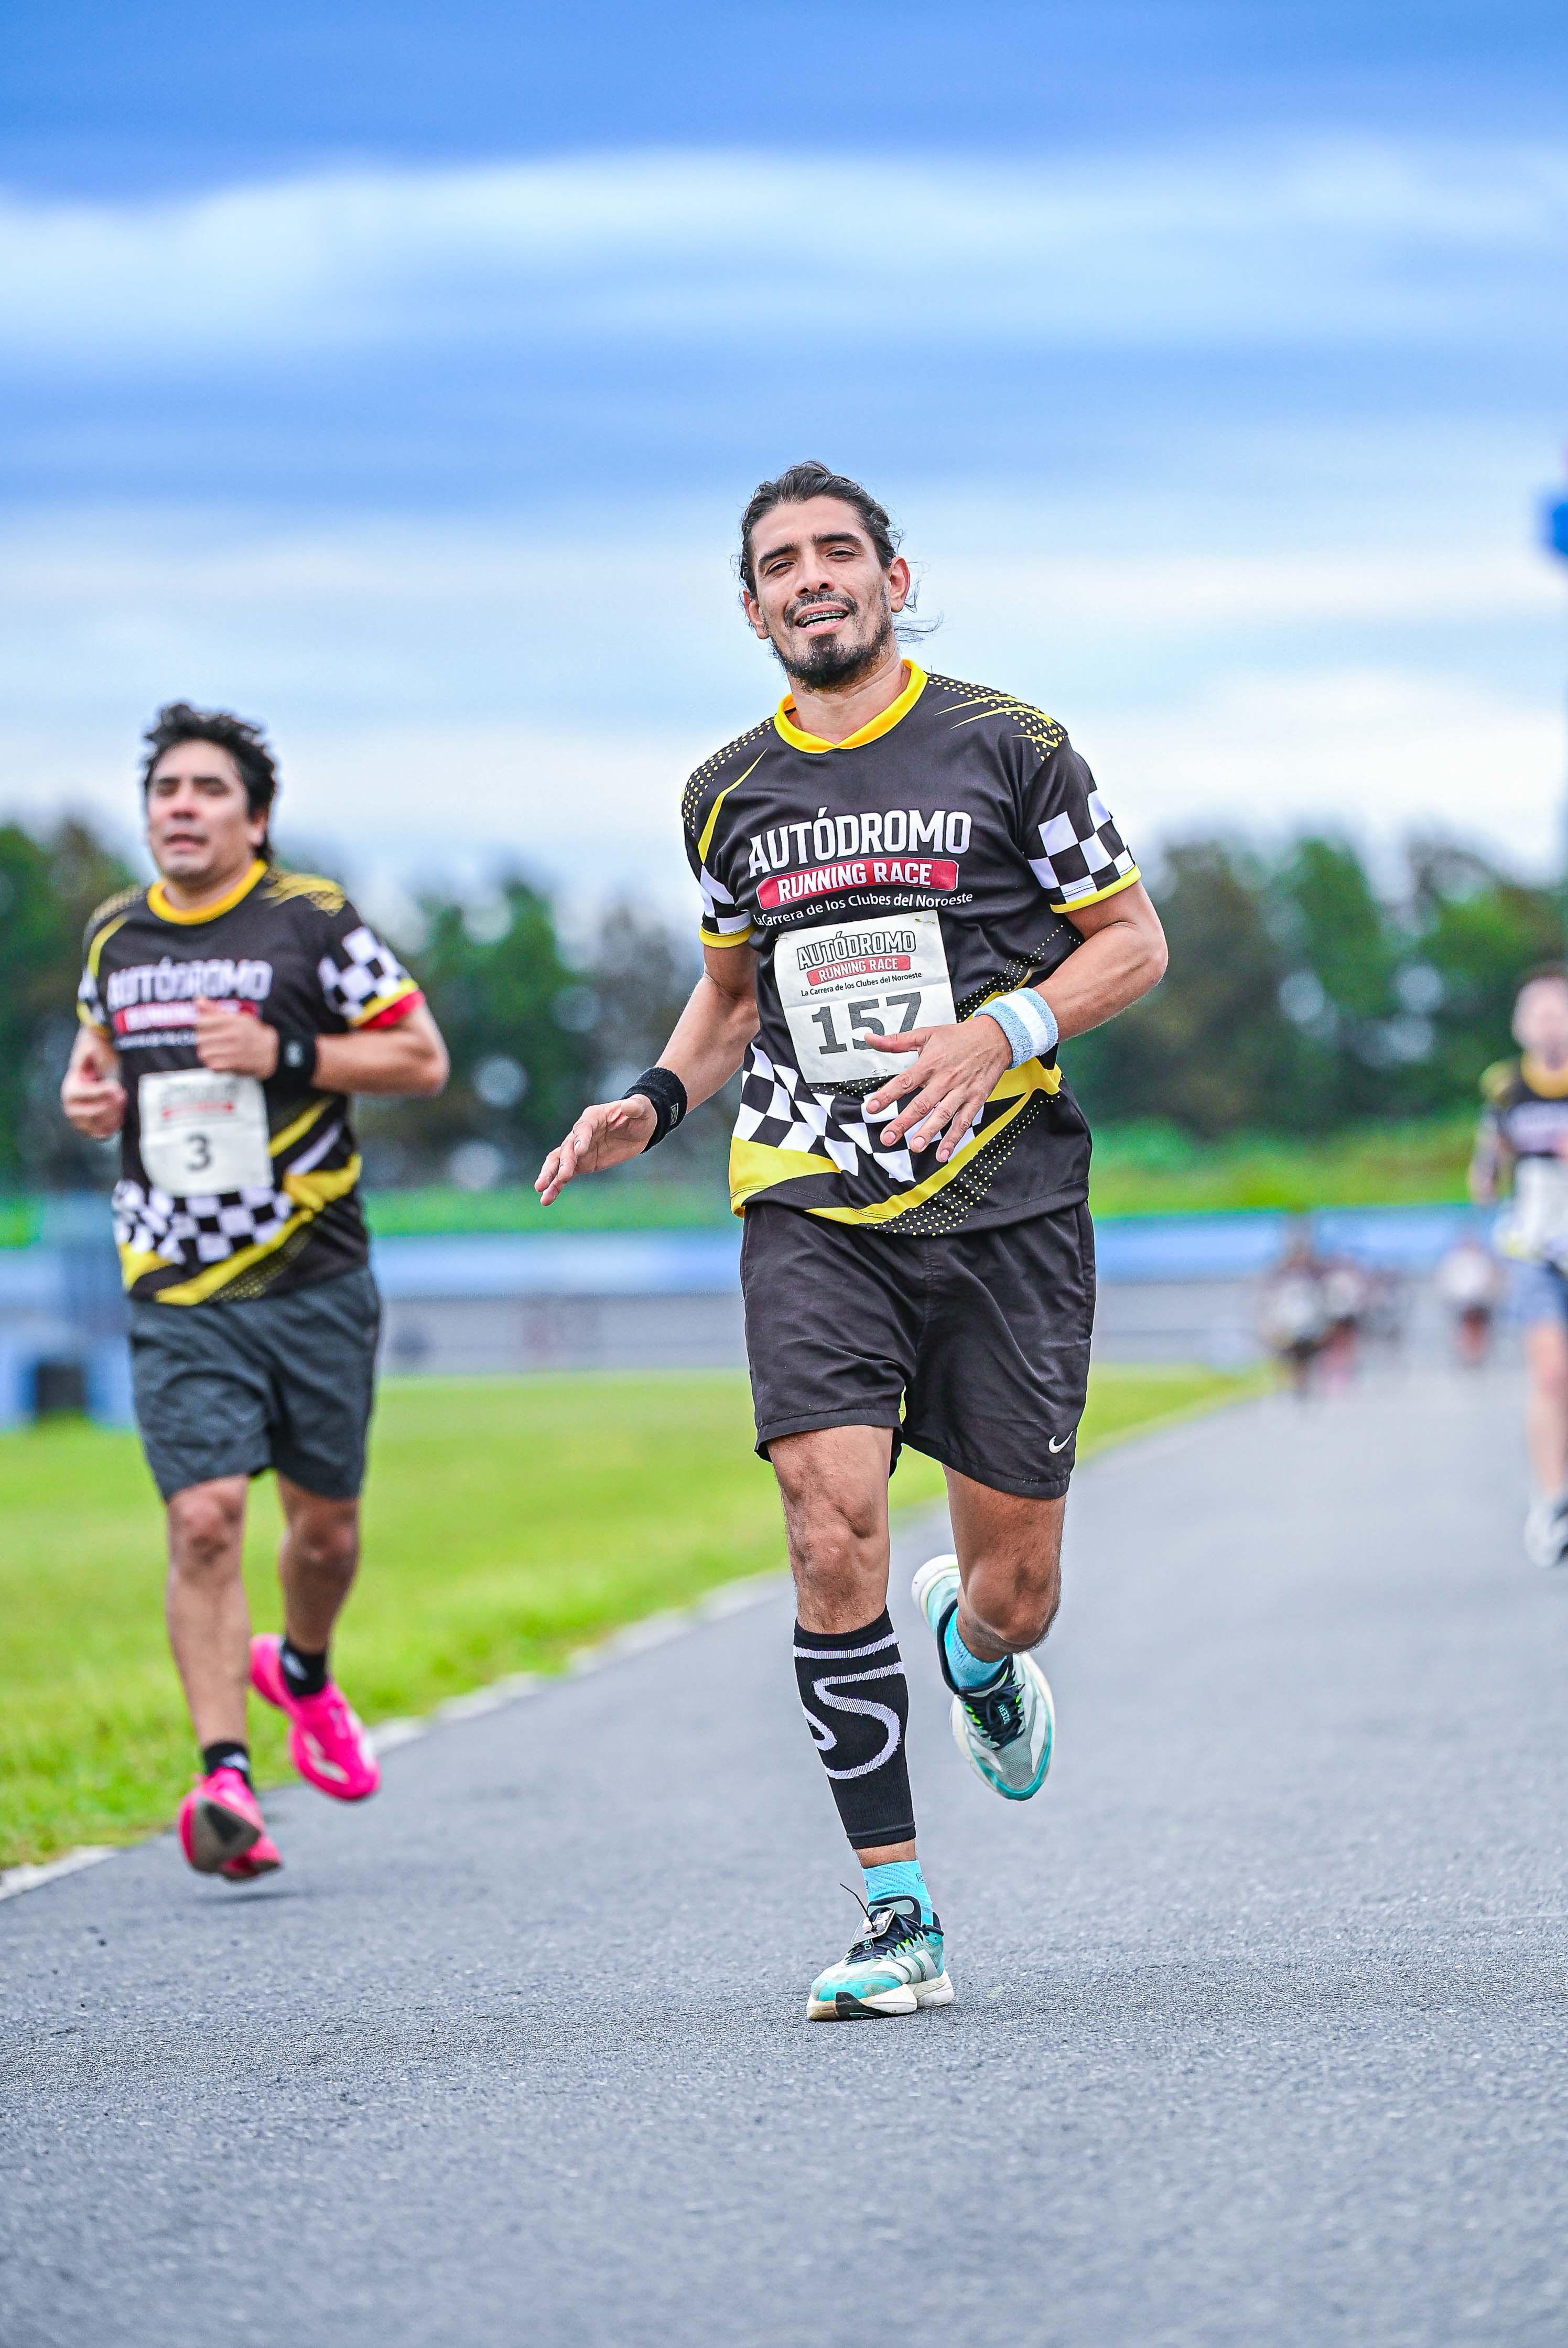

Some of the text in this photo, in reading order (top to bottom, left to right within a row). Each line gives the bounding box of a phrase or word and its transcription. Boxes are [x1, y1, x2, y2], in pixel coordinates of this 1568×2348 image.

[749, 806, 972, 878] AUTÓDROMO
[776, 861, 932, 902] RUNNING RACE
[762, 910, 804, 927] Carrera
[806, 903, 824, 915] de
[825, 900, 846, 911] los
[848, 893, 891, 907] Clubes
[893, 893, 914, 907] del
[916, 893, 973, 908] Noroeste
[796, 930, 916, 971] AUTÓDROMO
[817, 957, 898, 982] RUNNING RACE
[809, 986, 834, 995] Carrera
[856, 978, 879, 987] Clubes
[892, 972, 922, 982] Noroeste
[812, 992, 922, 1054] 157
[185, 1133, 212, 1172] 3
